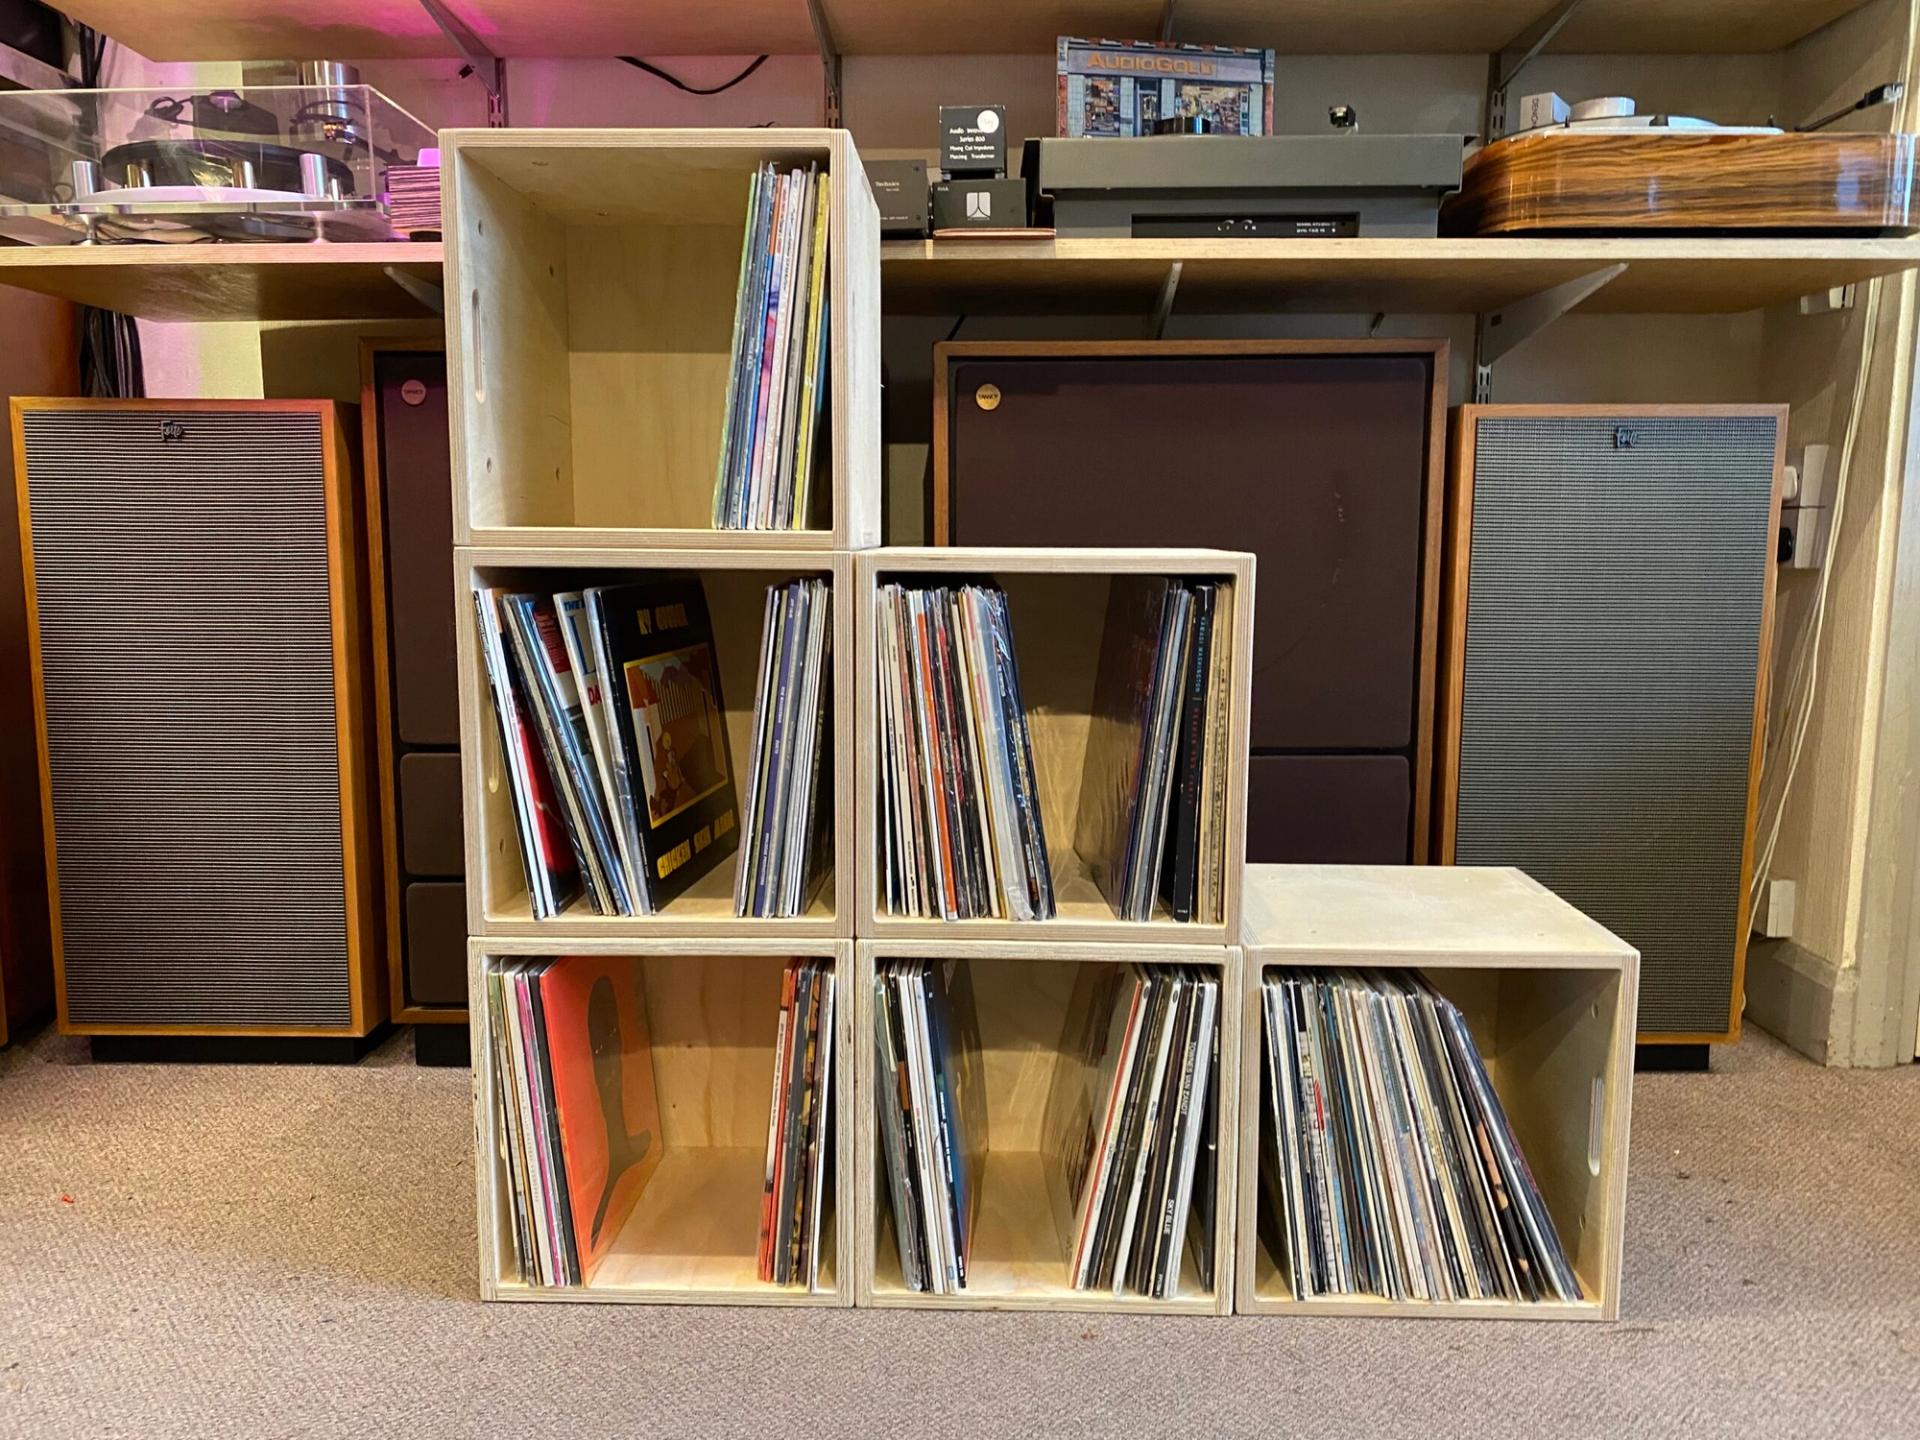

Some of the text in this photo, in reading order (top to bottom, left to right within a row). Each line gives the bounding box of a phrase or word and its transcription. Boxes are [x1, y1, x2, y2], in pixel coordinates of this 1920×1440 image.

[1087, 52, 1217, 76] AUDIOGOLD
[656, 838, 691, 880] CHICKEN
[1184, 1074, 1193, 1090] VAN
[1180, 1090, 1190, 1115] ZANDT
[1163, 1198, 1175, 1235] SKY BLUE
